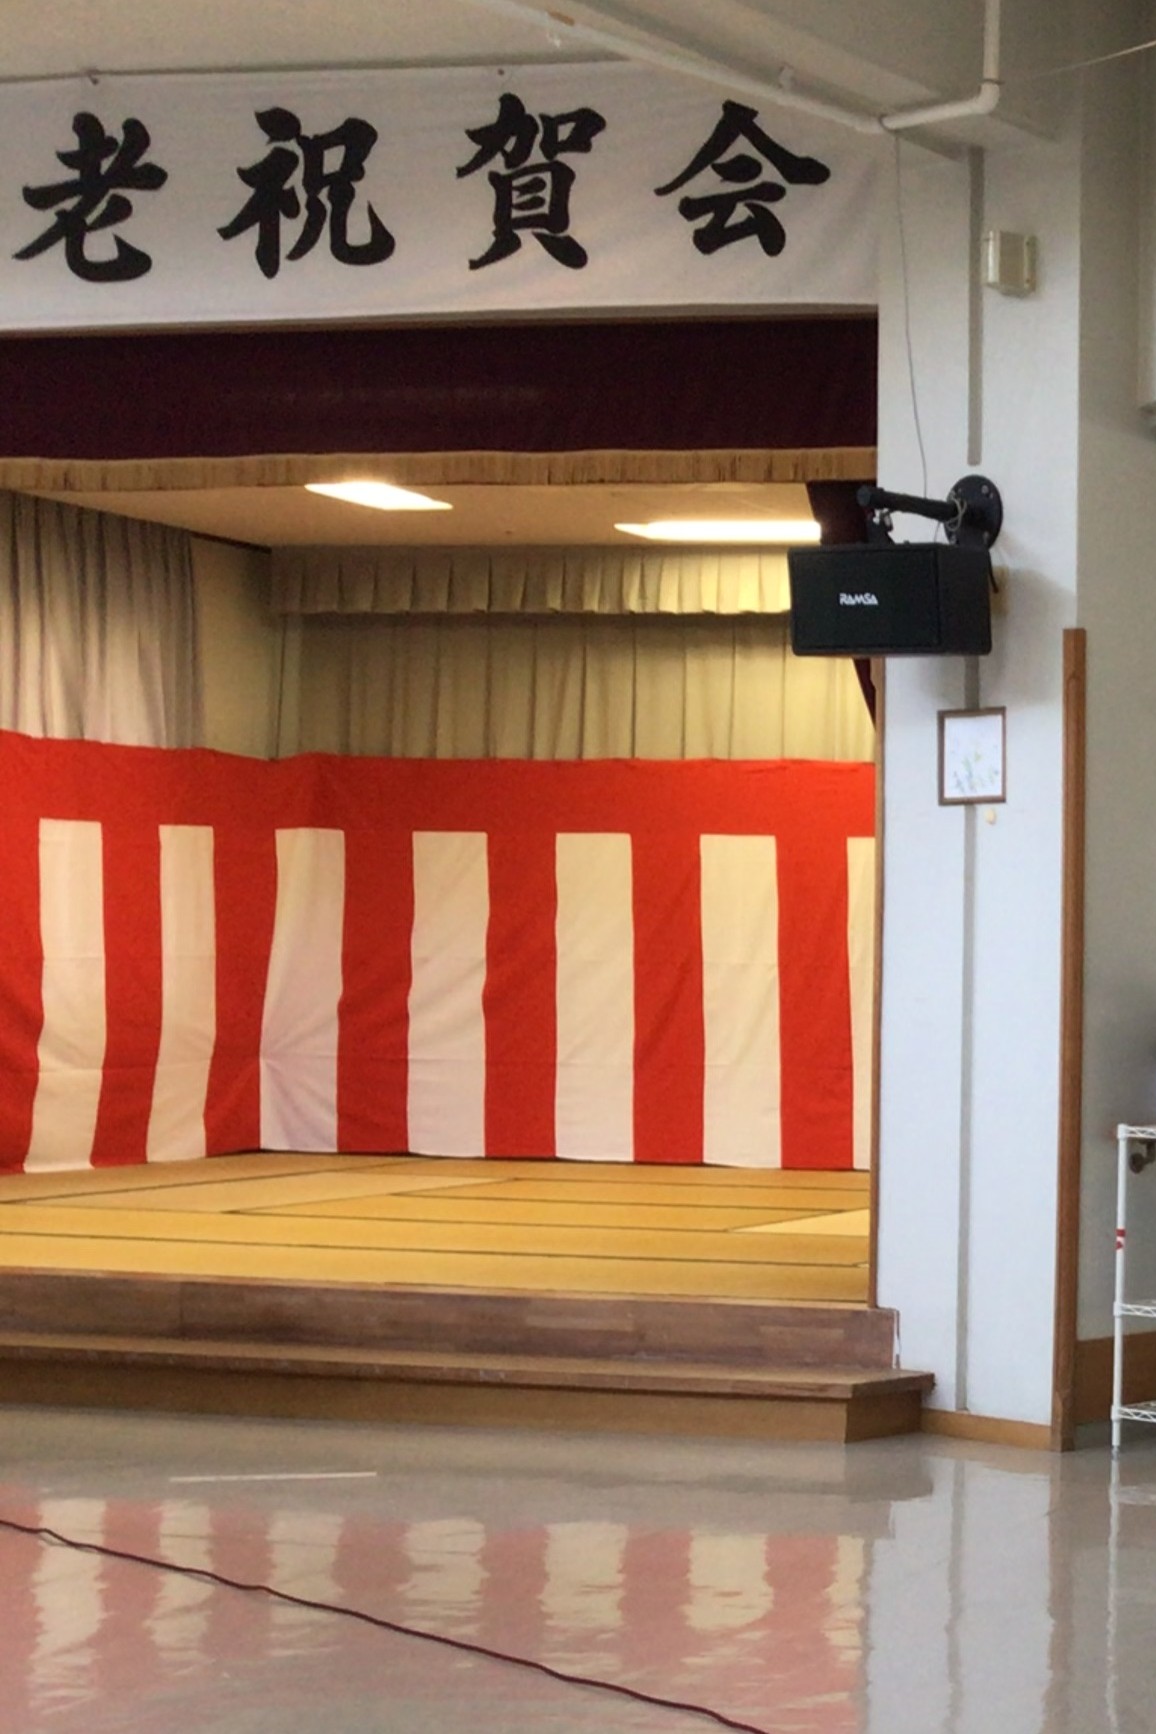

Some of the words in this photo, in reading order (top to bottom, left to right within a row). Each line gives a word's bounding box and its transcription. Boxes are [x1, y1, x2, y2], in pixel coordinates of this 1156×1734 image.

[13, 92, 832, 283] 老祝賀会
[839, 592, 879, 606] RAMSA
